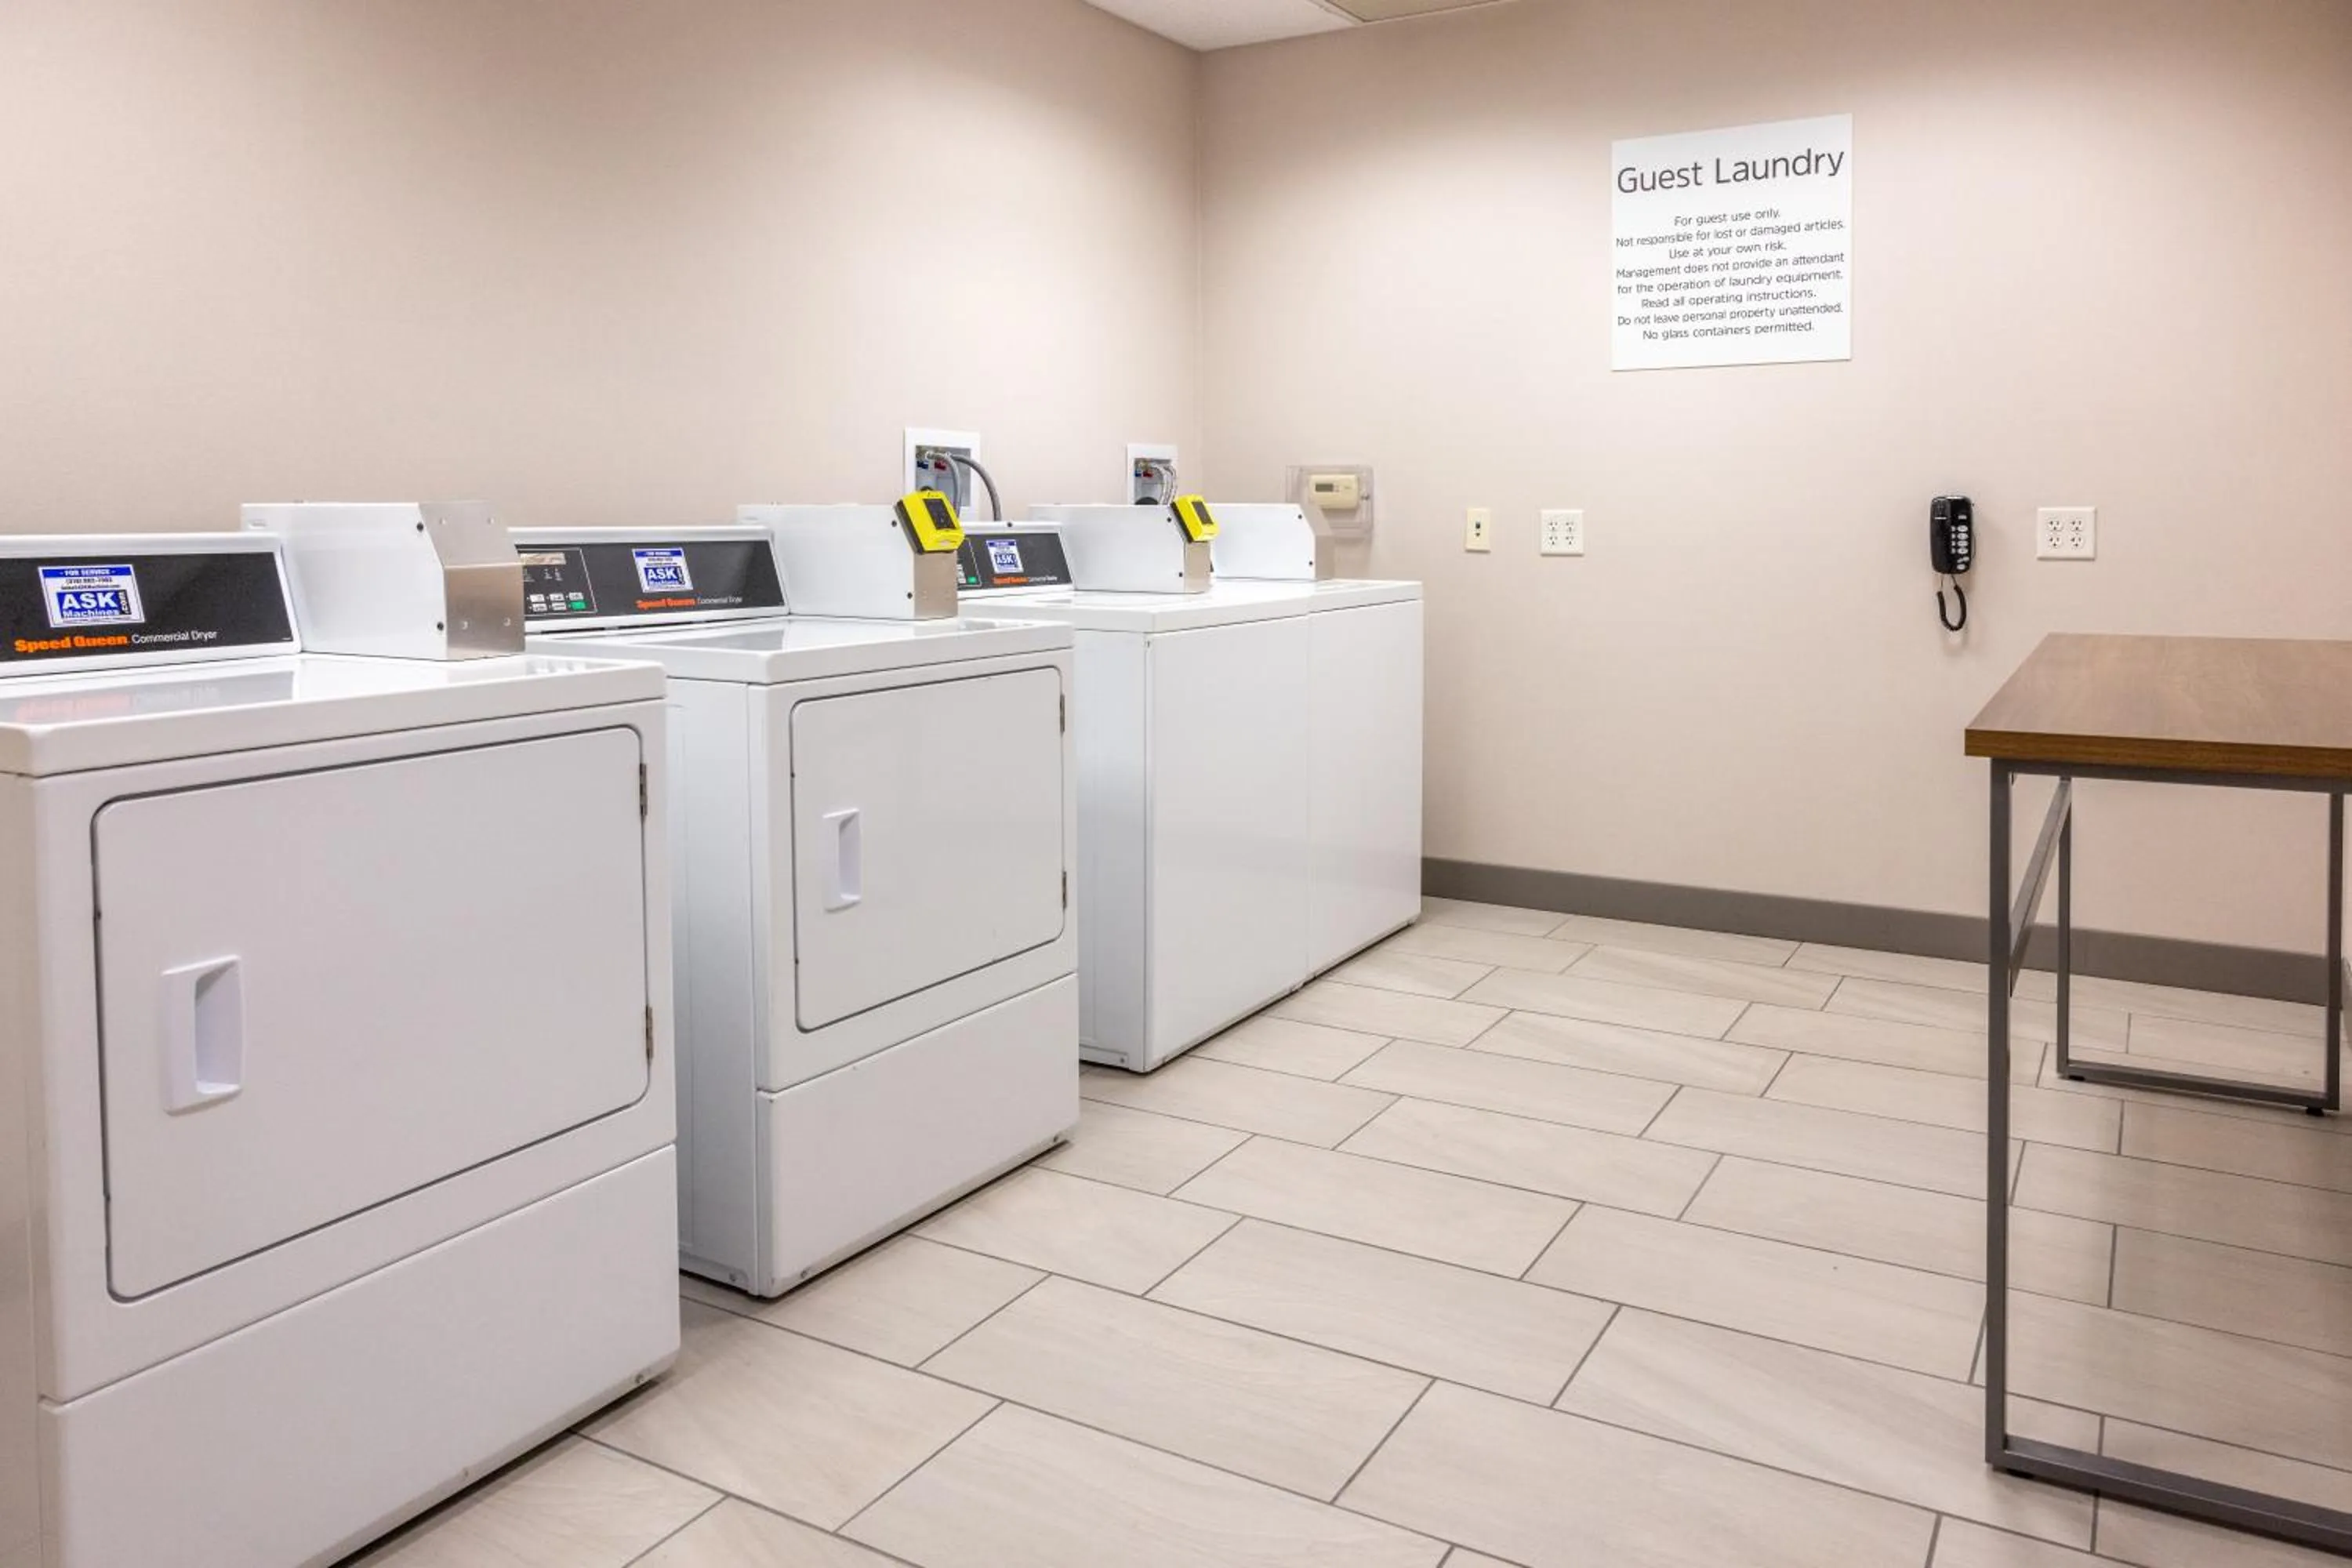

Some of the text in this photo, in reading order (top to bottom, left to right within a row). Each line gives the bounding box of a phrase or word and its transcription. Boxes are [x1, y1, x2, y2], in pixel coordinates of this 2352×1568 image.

[1617, 147, 1845, 194] Guest Laundry
[1674, 208, 1780, 227] For guest use only.
[1616, 219, 1846, 248] Not responsible for lost or damaged articles.
[1668, 240, 1787, 260] Use at your own risk.
[1616, 252, 1844, 278] Management does not provide an attendant
[1617, 269, 1843, 295] for the operation of laundry equipment.
[1642, 288, 1817, 309] Read all operating instructions.
[1617, 302, 1843, 326] Do not leave personal property unattended.
[1642, 320, 1815, 341] No glass containers permitted.
[648, 567, 677, 580] ASK
[63, 591, 118, 610] ASK
[63, 608, 120, 619] Machines
[14, 630, 218, 653] Speed Queen Commercial Dryer
